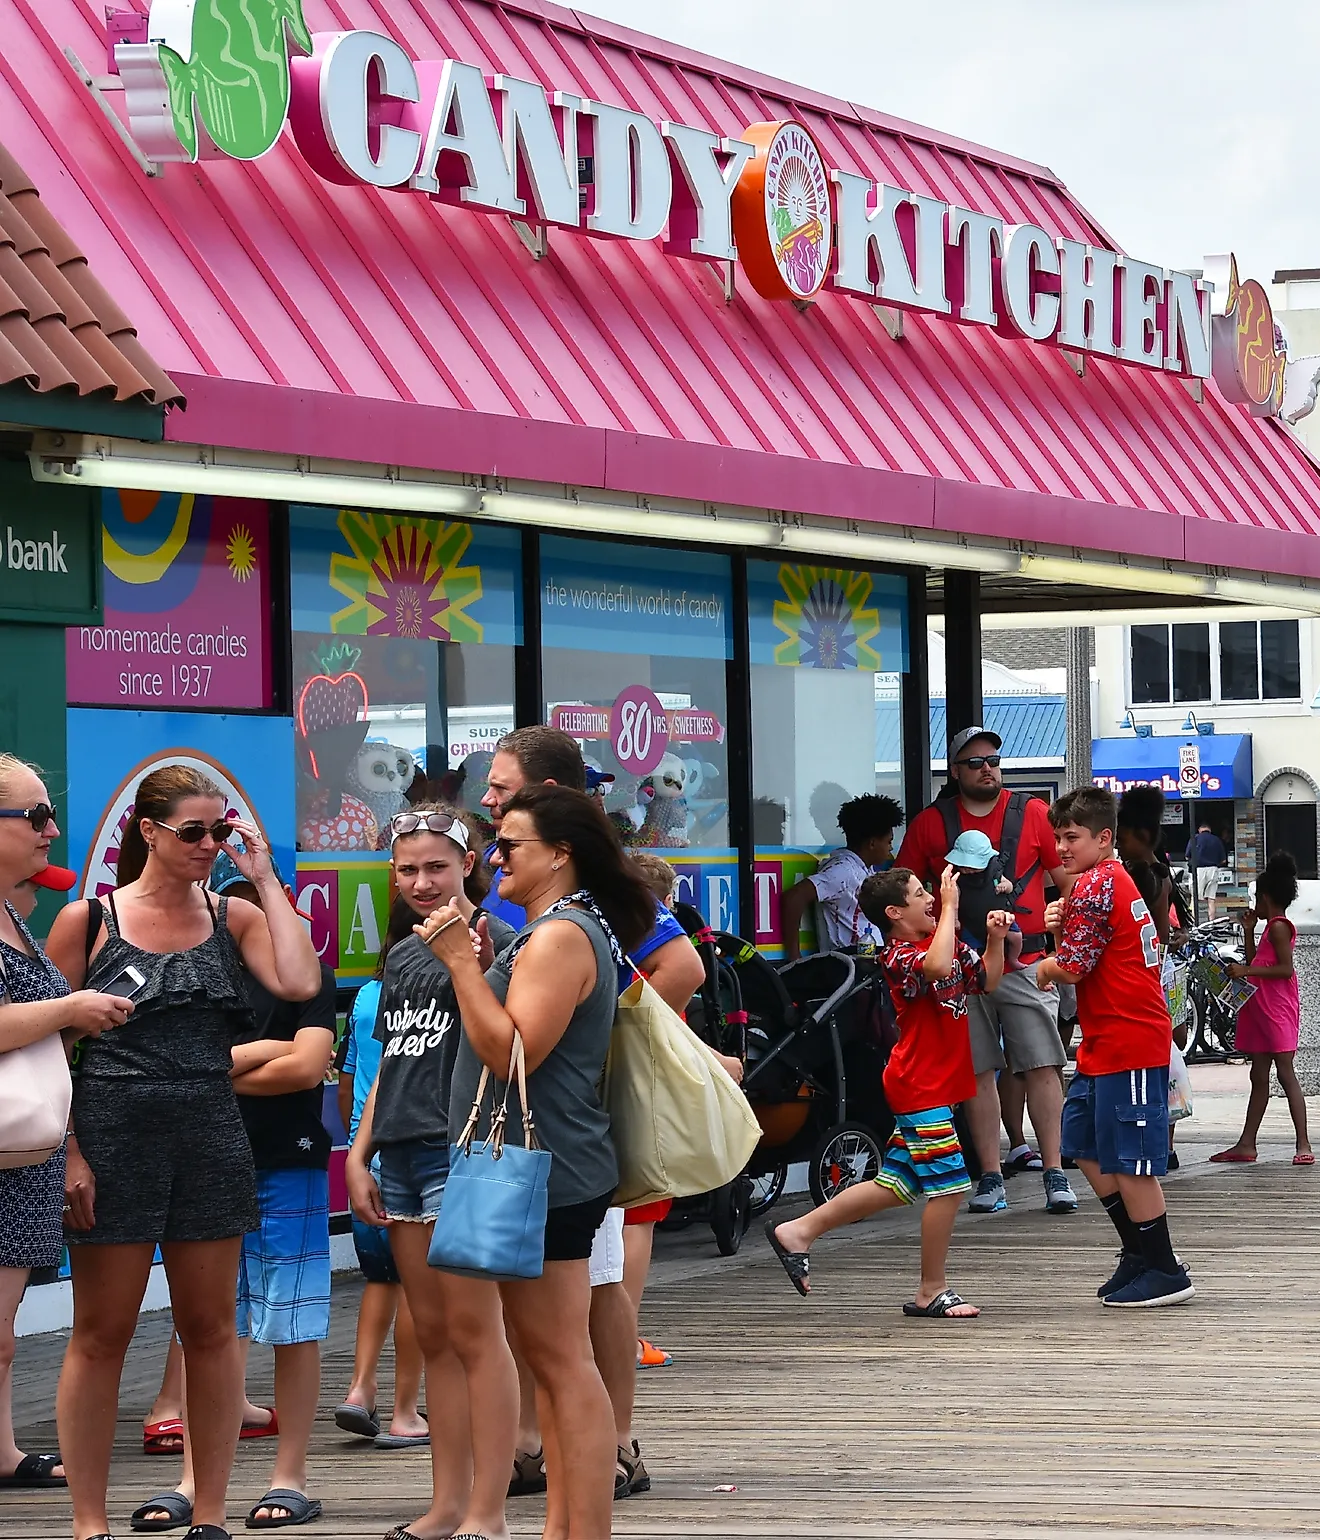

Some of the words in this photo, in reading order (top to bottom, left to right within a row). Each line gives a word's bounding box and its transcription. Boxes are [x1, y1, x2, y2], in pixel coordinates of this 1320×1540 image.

[768, 131, 789, 200] CANDY
[791, 130, 827, 218] KITCHEN
[314, 29, 756, 261] CANDY
[831, 169, 1215, 379] KITCHEN
[7, 526, 69, 573] bank
[545, 577, 567, 606] the
[570, 584, 633, 613] wonderful
[636, 589, 671, 616] world
[674, 591, 687, 617] of
[689, 593, 722, 628] candy
[187, 625, 247, 657] candies
[119, 663, 163, 695] since
[172, 665, 212, 697] 1937
[469, 727, 508, 738] SUBS
[559, 712, 608, 733] CELEBRATING
[617, 701, 652, 761] 80
[652, 716, 668, 734] YRS.
[675, 716, 713, 735] SWEETNESS
[1181, 756, 1196, 764] LANE
